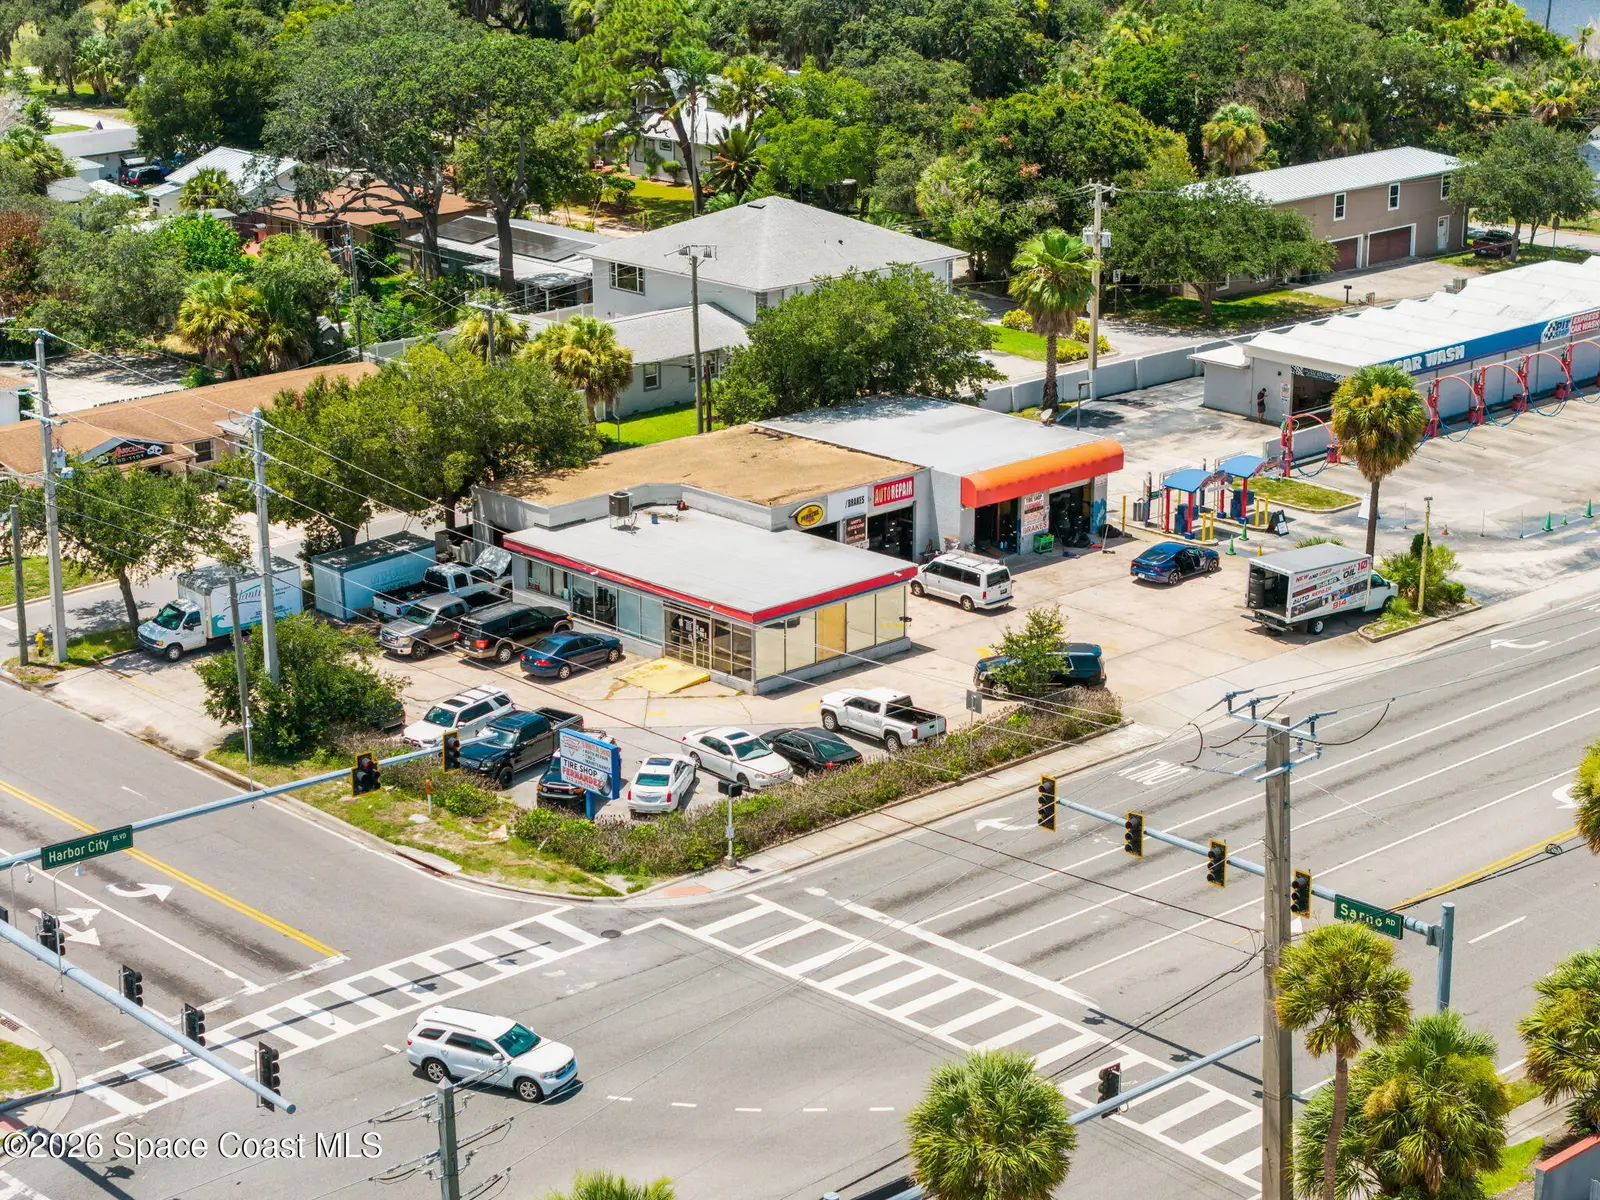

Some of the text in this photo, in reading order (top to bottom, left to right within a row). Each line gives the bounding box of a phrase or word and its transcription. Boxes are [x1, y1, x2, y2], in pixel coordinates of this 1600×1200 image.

[1574, 312, 1599, 324] EXPRESS
[1571, 324, 1582, 332] CAR
[1394, 345, 1465, 373] CAR WASH
[1295, 574, 1309, 582] NEW
[1343, 568, 1356, 579] OIL
[1293, 595, 1310, 605] AUTO
[563, 759, 598, 777] TIRE SHOP
[562, 766, 604, 787] FERNANDEZ
[48, 832, 127, 862] Harbor City BLVD
[1340, 903, 1396, 927] Sarno RD
